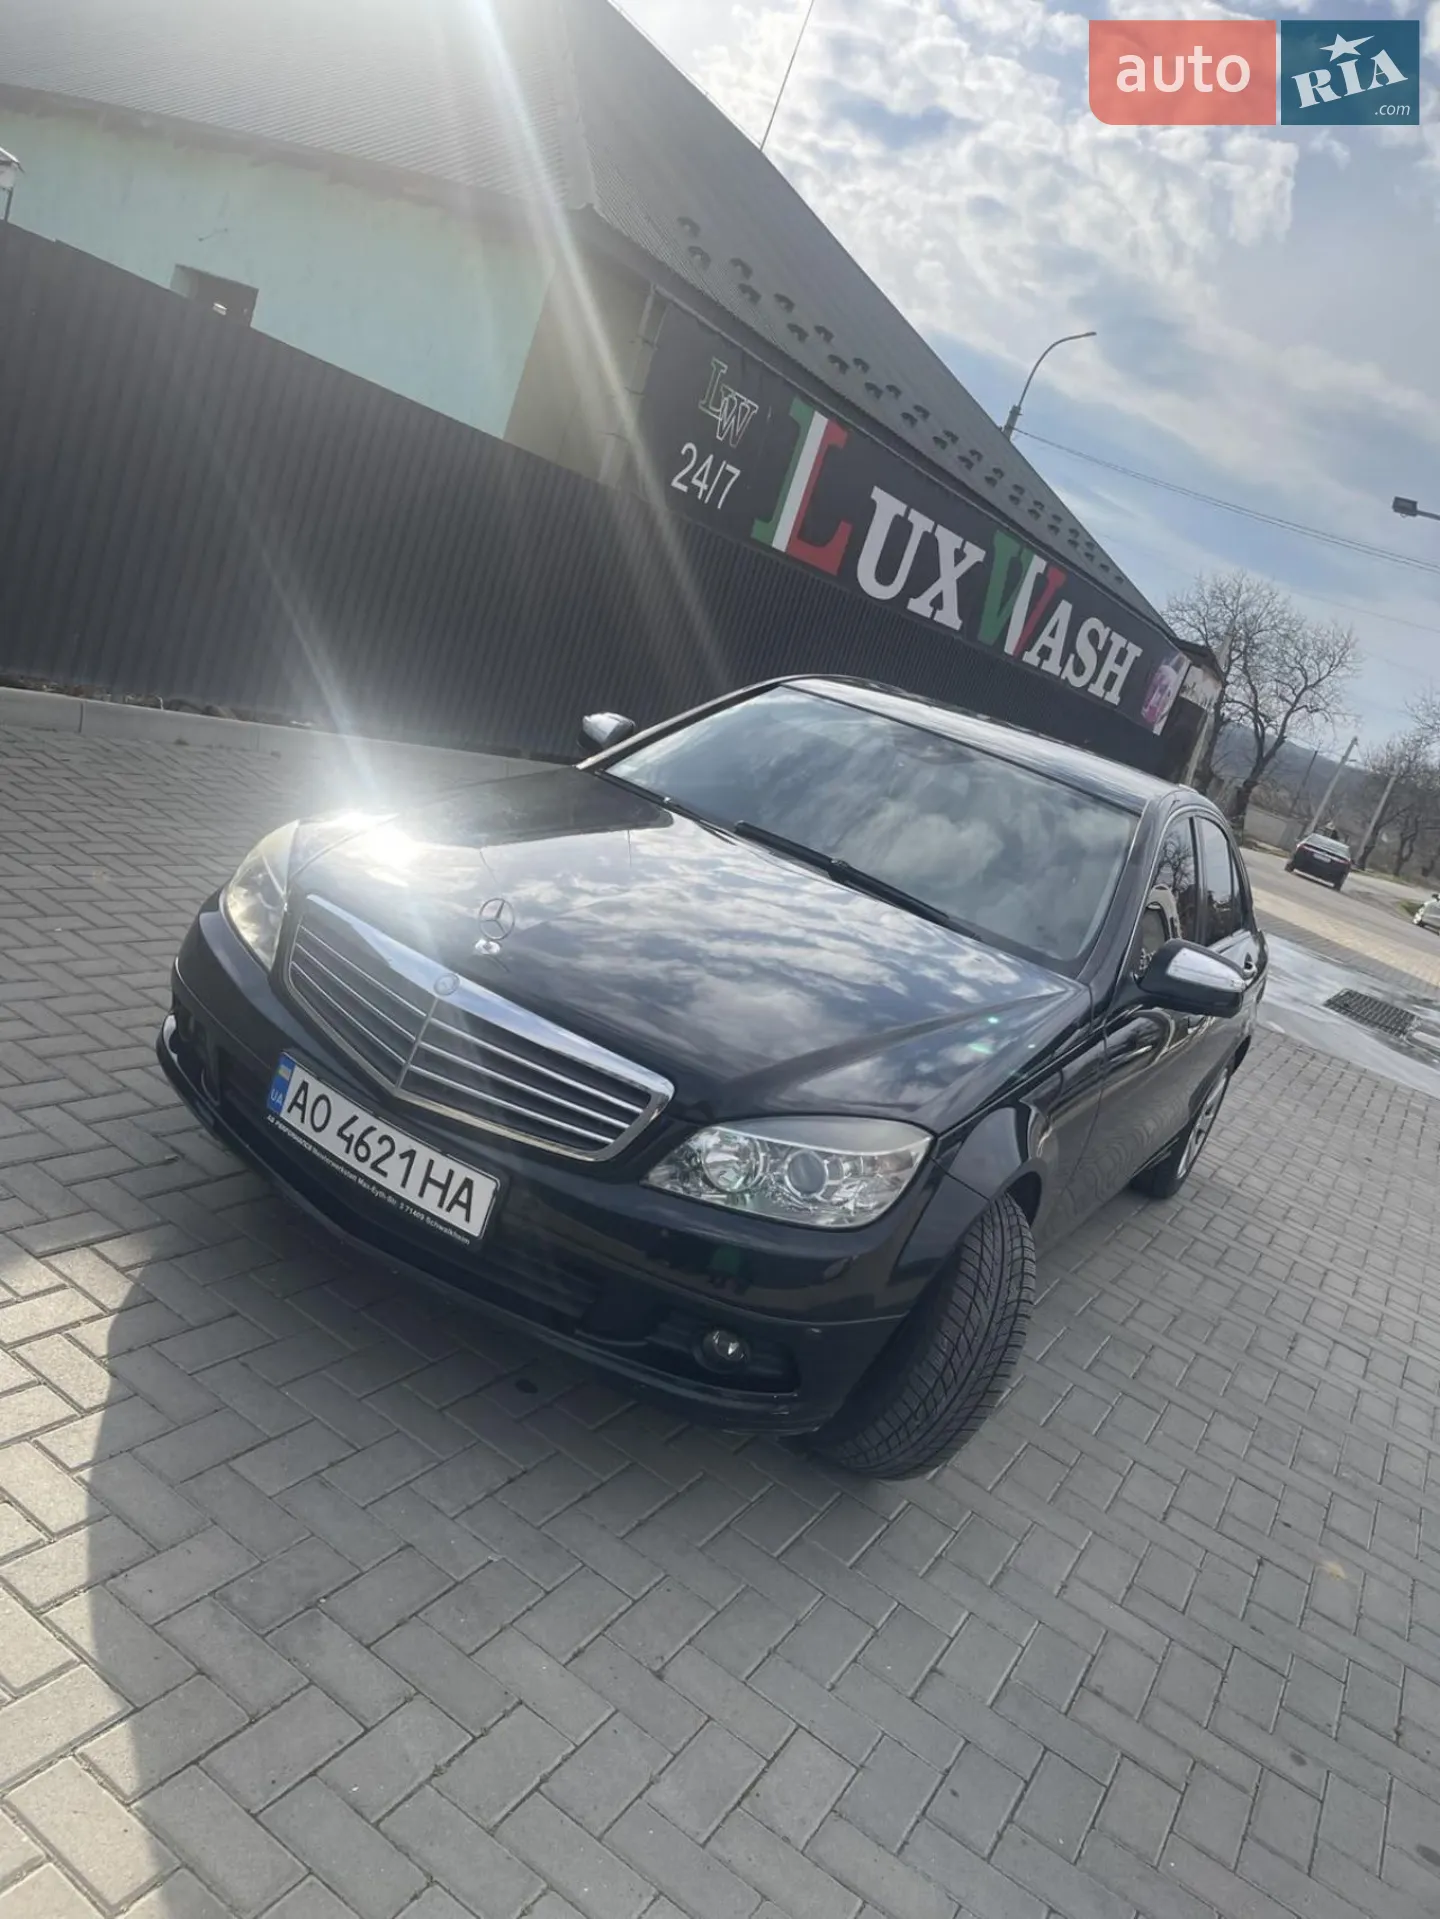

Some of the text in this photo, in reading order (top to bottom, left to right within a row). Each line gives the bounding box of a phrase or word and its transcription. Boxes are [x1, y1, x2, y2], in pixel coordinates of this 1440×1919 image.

[671, 442, 741, 510] 24/7
[270, 1088, 284, 1107] UA
[287, 1080, 474, 1223] AO 4621 HA
